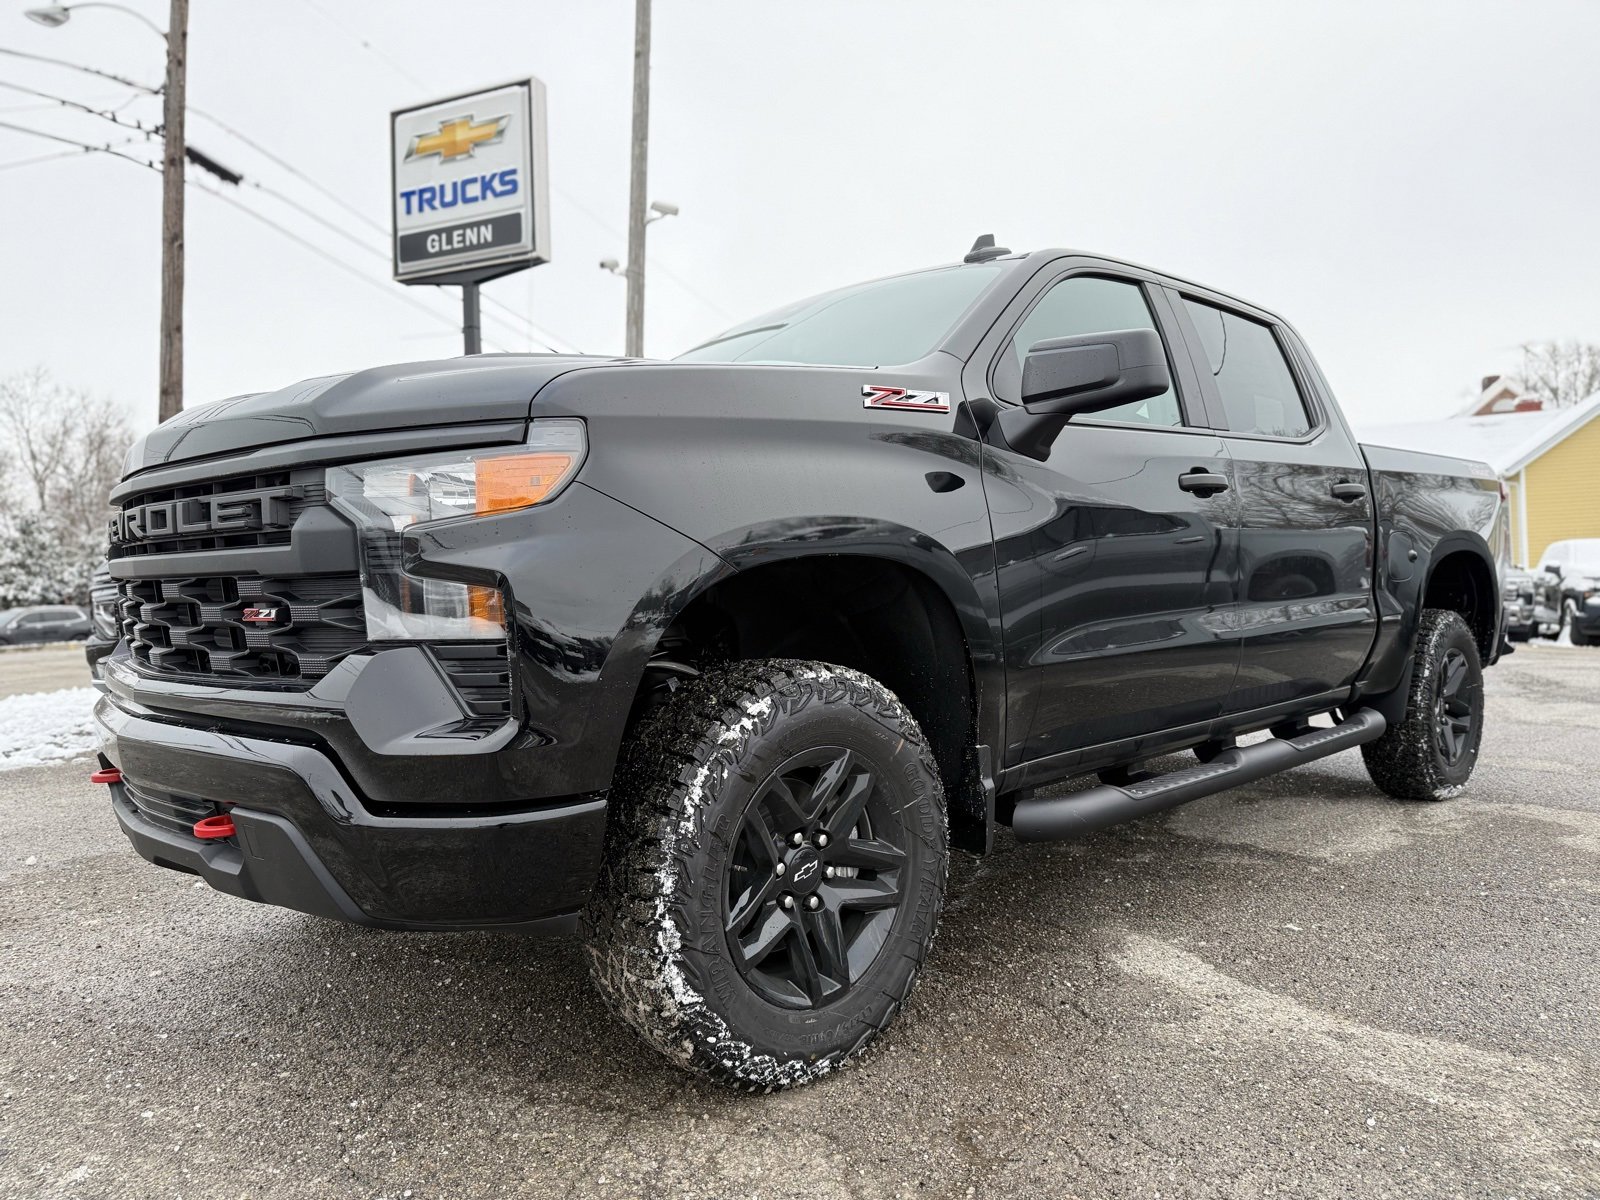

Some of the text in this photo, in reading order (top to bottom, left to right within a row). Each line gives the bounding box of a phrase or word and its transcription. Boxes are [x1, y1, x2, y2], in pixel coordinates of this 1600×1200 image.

[400, 168, 519, 215] TRUCKS
[426, 224, 493, 253] GLENN
[862, 384, 950, 414] Z71
